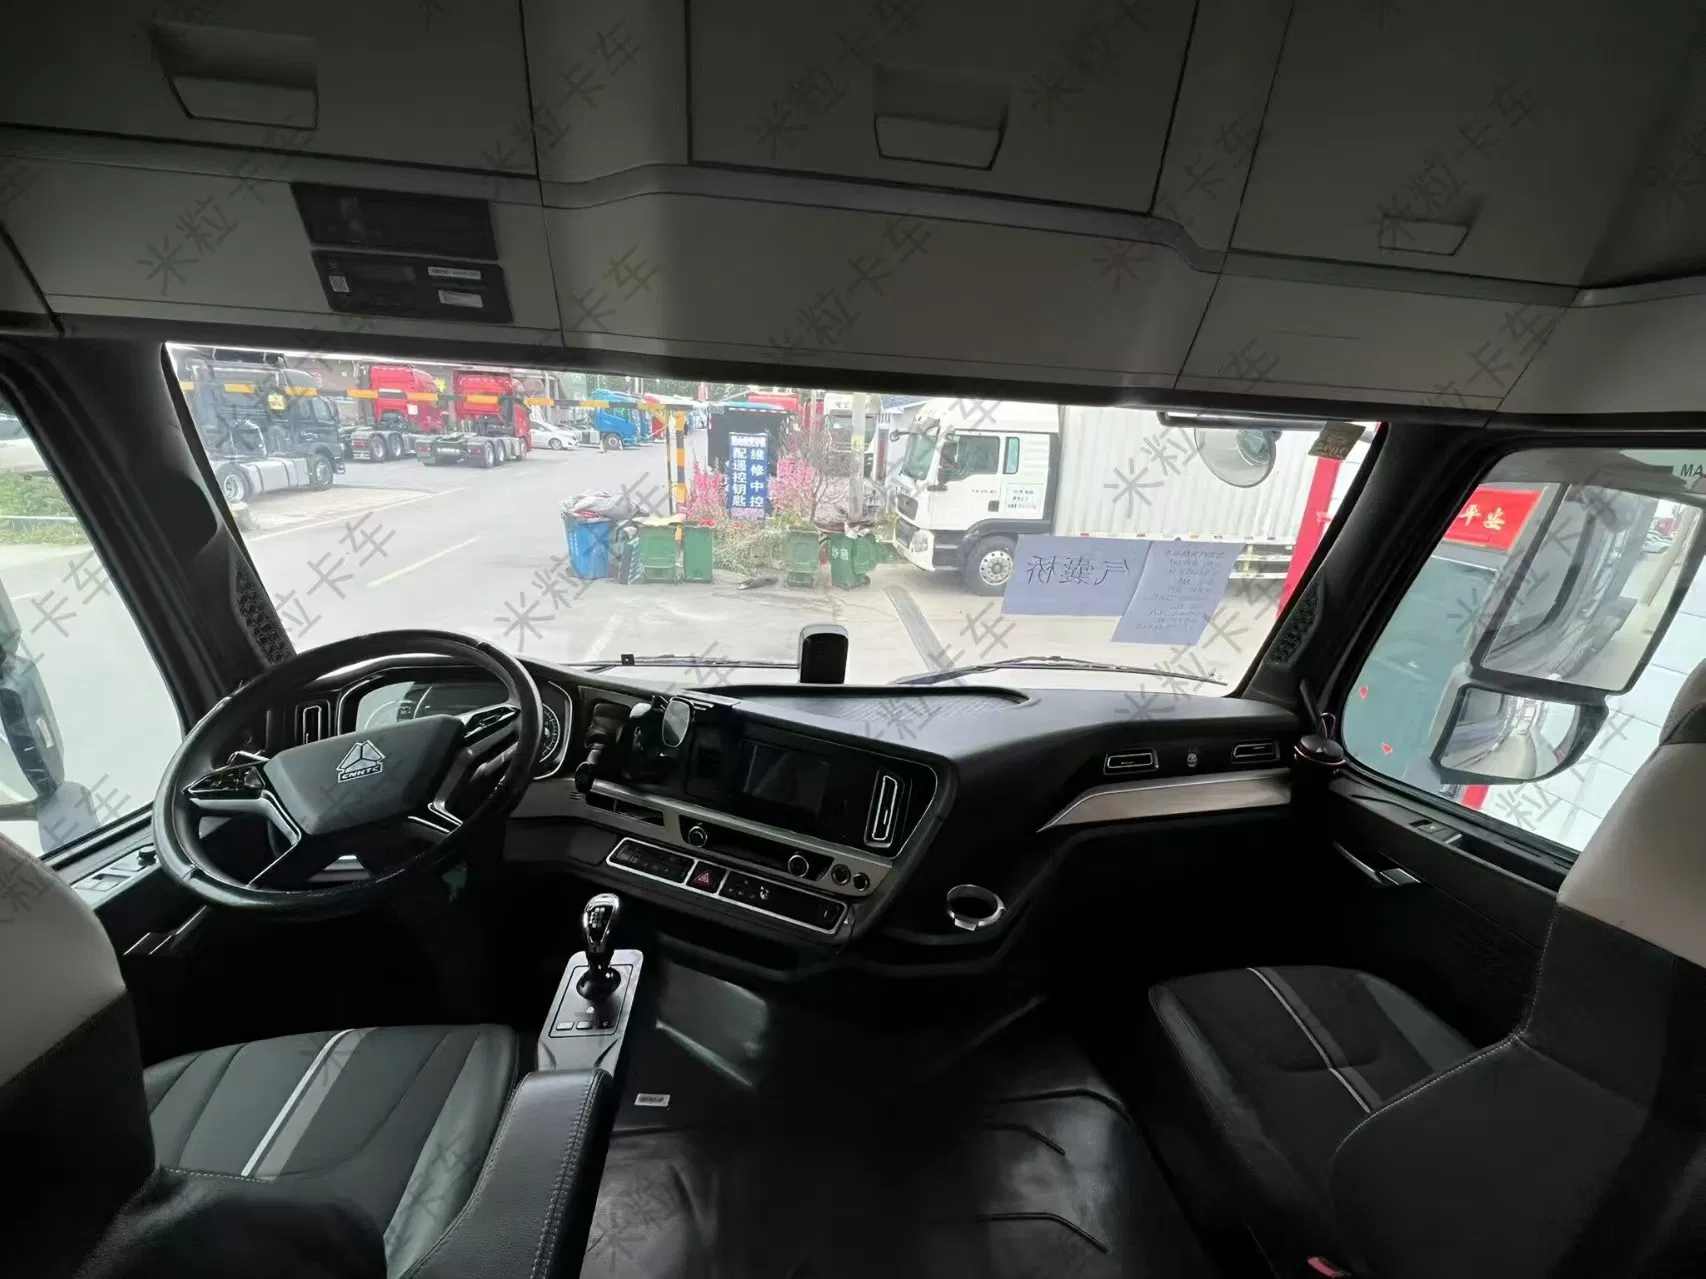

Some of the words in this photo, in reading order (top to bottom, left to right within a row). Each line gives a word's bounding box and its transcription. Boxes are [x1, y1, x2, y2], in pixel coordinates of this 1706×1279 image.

[750, 448, 765, 507] 维修中控
[1459, 503, 1505, 531] 平安
